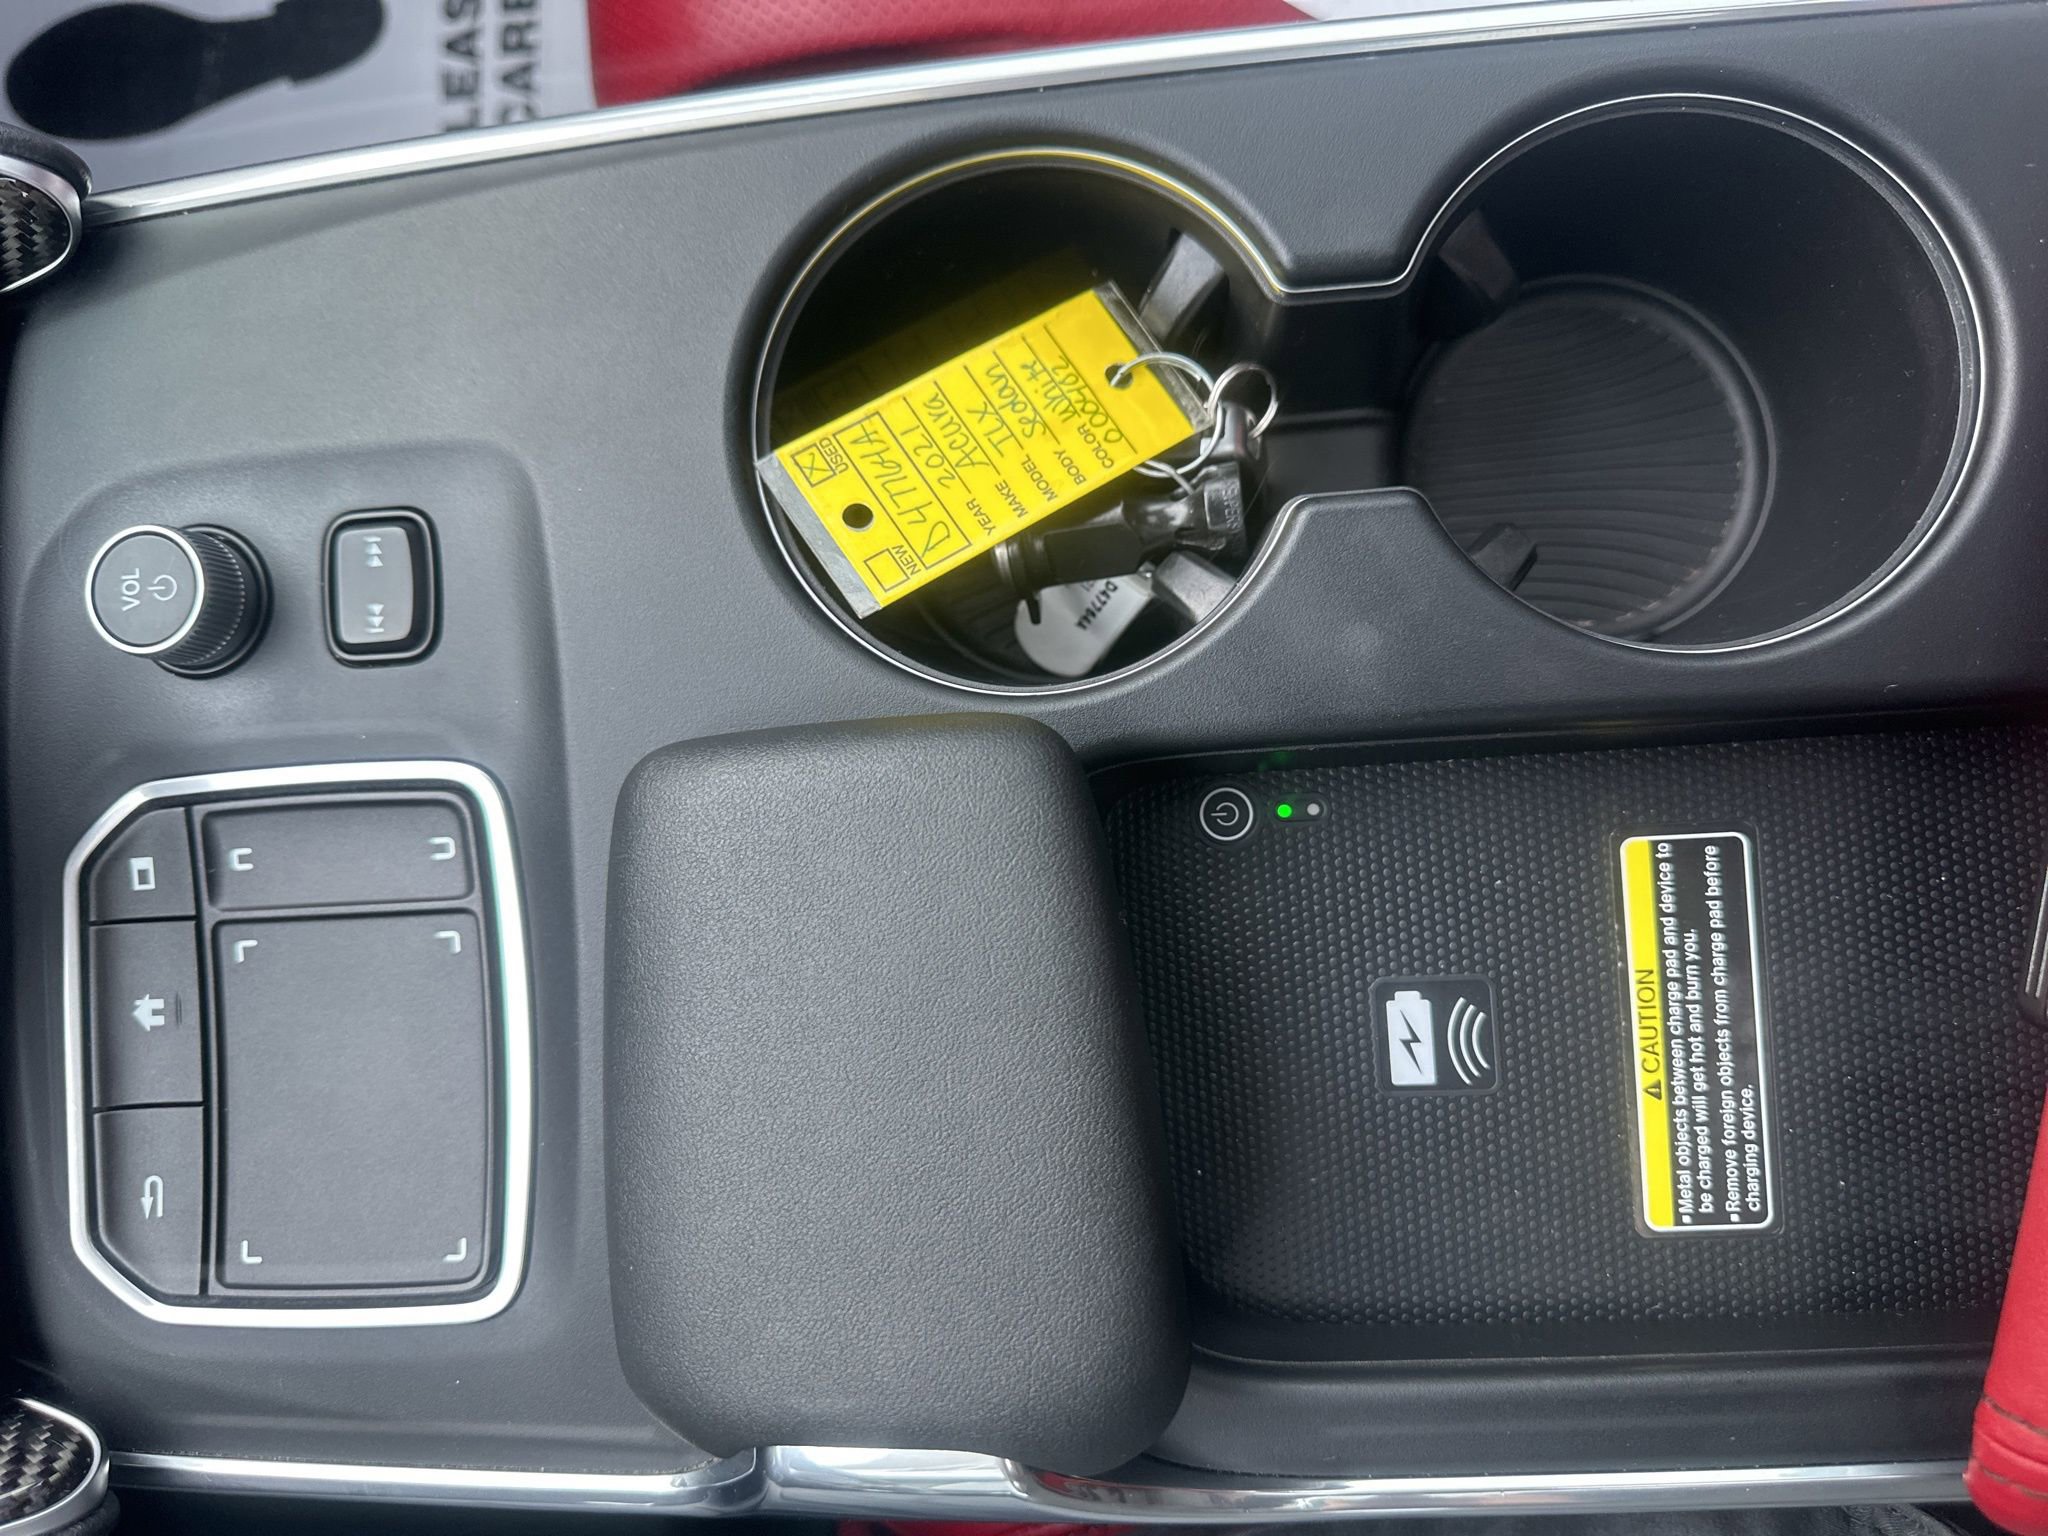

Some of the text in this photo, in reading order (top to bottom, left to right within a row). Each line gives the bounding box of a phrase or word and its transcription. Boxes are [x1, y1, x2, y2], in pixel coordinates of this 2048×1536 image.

[966, 401, 1015, 458] TLX
[985, 364, 1047, 439] Sedan
[818, 436, 849, 474] USED
[900, 424, 956, 490] 2021
[923, 393, 990, 468] Acura
[1077, 422, 1114, 469] COLOR
[1020, 454, 1058, 502] MODEL
[1053, 449, 1087, 486] BODY
[966, 498, 996, 536] YEAR
[994, 479, 1029, 518] MAKE
[892, 544, 921, 576] NEW
[121, 567, 140, 612] VOL
[1634, 968, 1661, 1073] CAUTION
[1656, 842, 1695, 1214] Metal objects between charge pad and device to
[1703, 845, 1742, 1212] Remove foreign objects from charge pad before
[1683, 928, 1714, 1213] be charged will get hot and burn you.
[1739, 1084, 1762, 1212] charging device.
